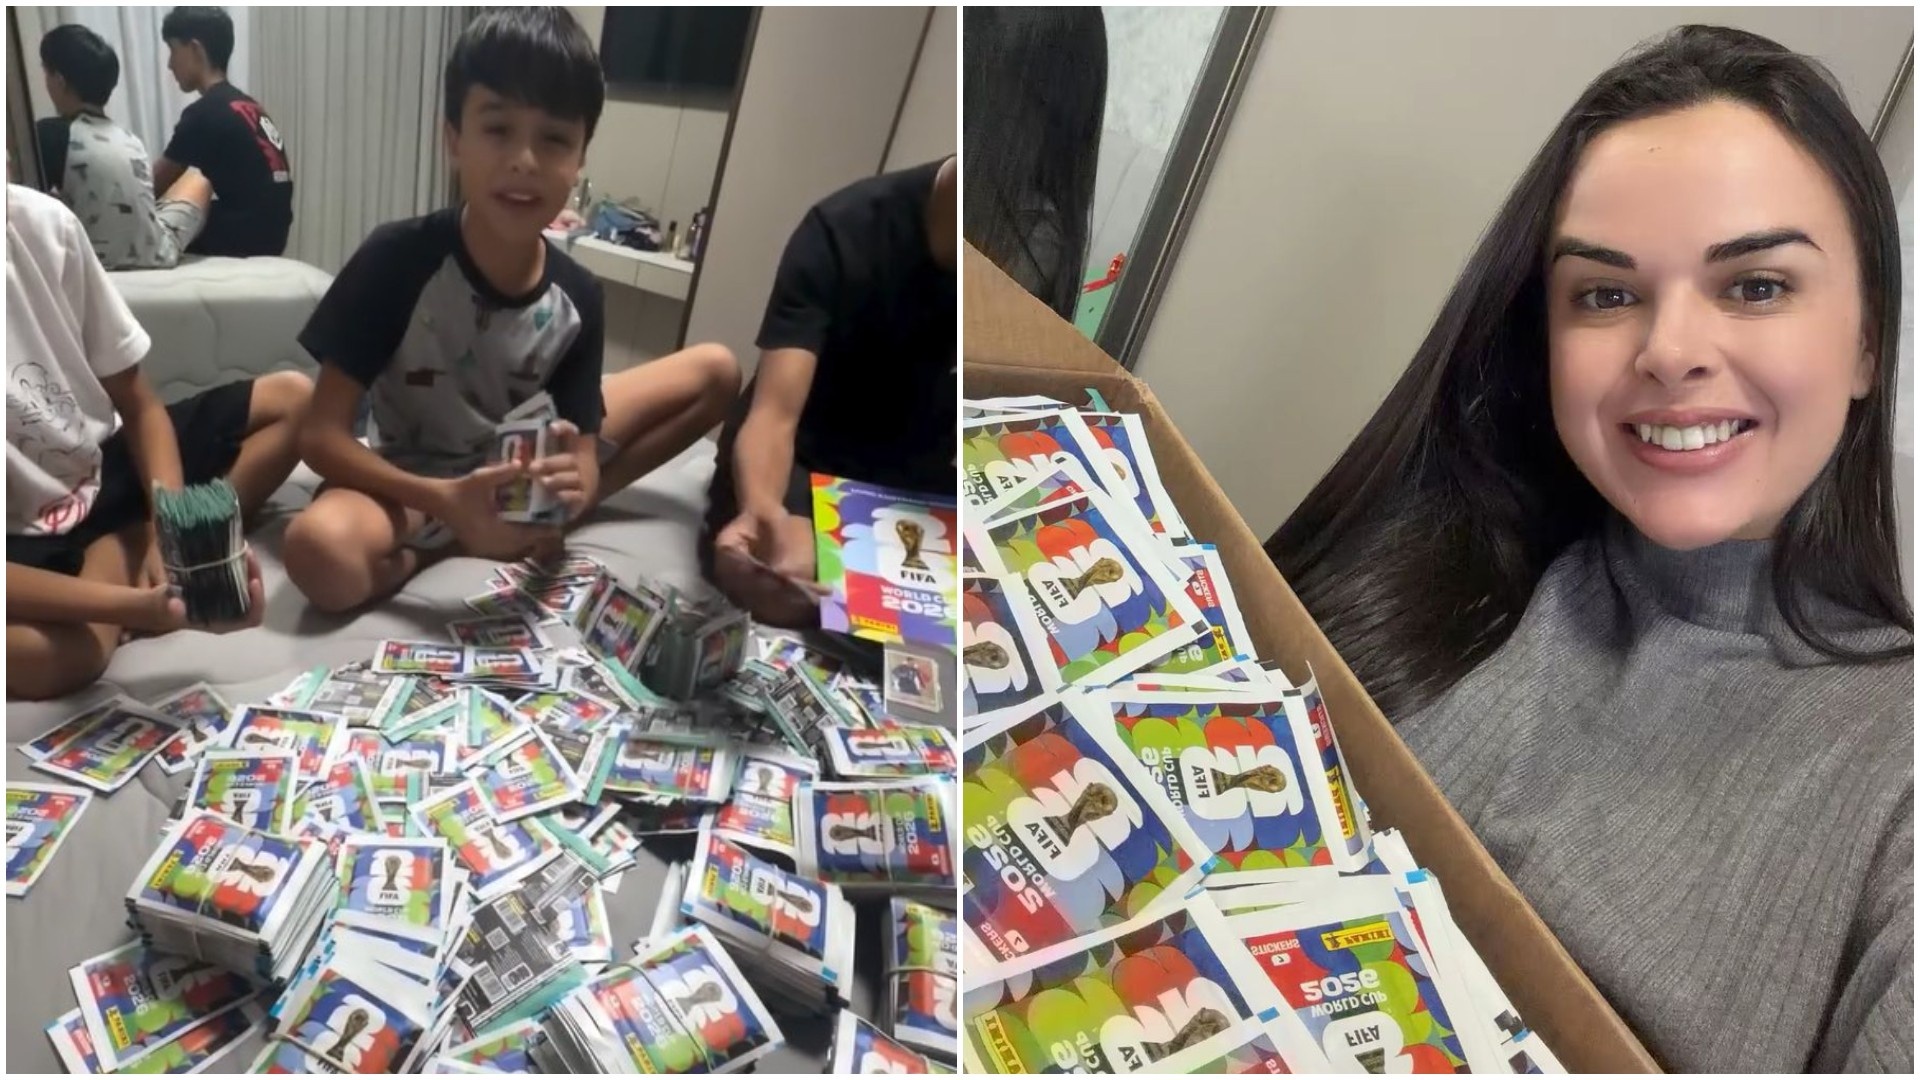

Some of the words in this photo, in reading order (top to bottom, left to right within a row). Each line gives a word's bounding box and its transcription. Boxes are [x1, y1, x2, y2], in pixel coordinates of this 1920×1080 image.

[900, 570, 936, 584] FIFA
[881, 585, 931, 601] WORLD
[905, 811, 920, 855] 2026
[124, 974, 149, 1015] 2026
